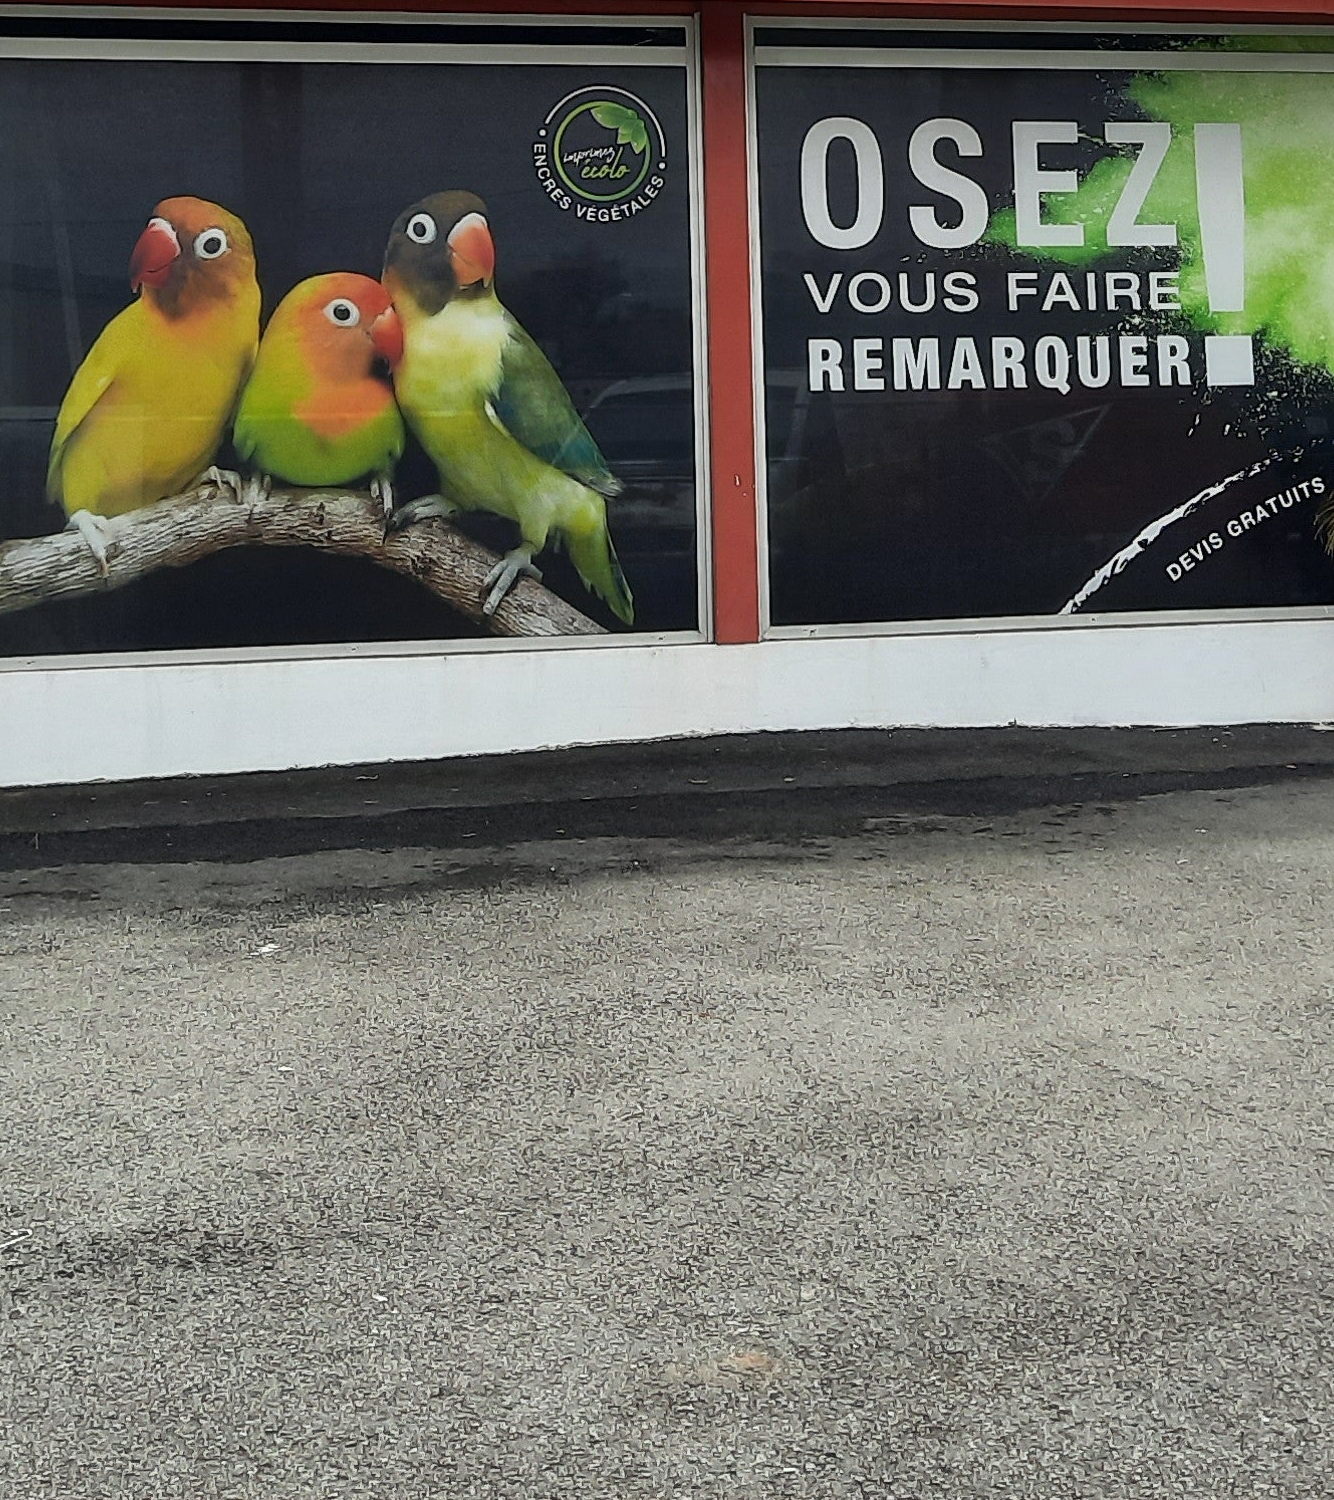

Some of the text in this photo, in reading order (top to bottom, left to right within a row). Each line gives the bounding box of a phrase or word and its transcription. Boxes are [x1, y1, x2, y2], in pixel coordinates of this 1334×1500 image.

[533, 143, 664, 222] ENCRES VÉGÉTALES
[800, 116, 1178, 250] OSEZ
[803, 271, 1182, 314] VOUS FAIRE
[807, 334, 1192, 396] REMARQUER
[1166, 476, 1326, 583] DEVIS GRATUITS
